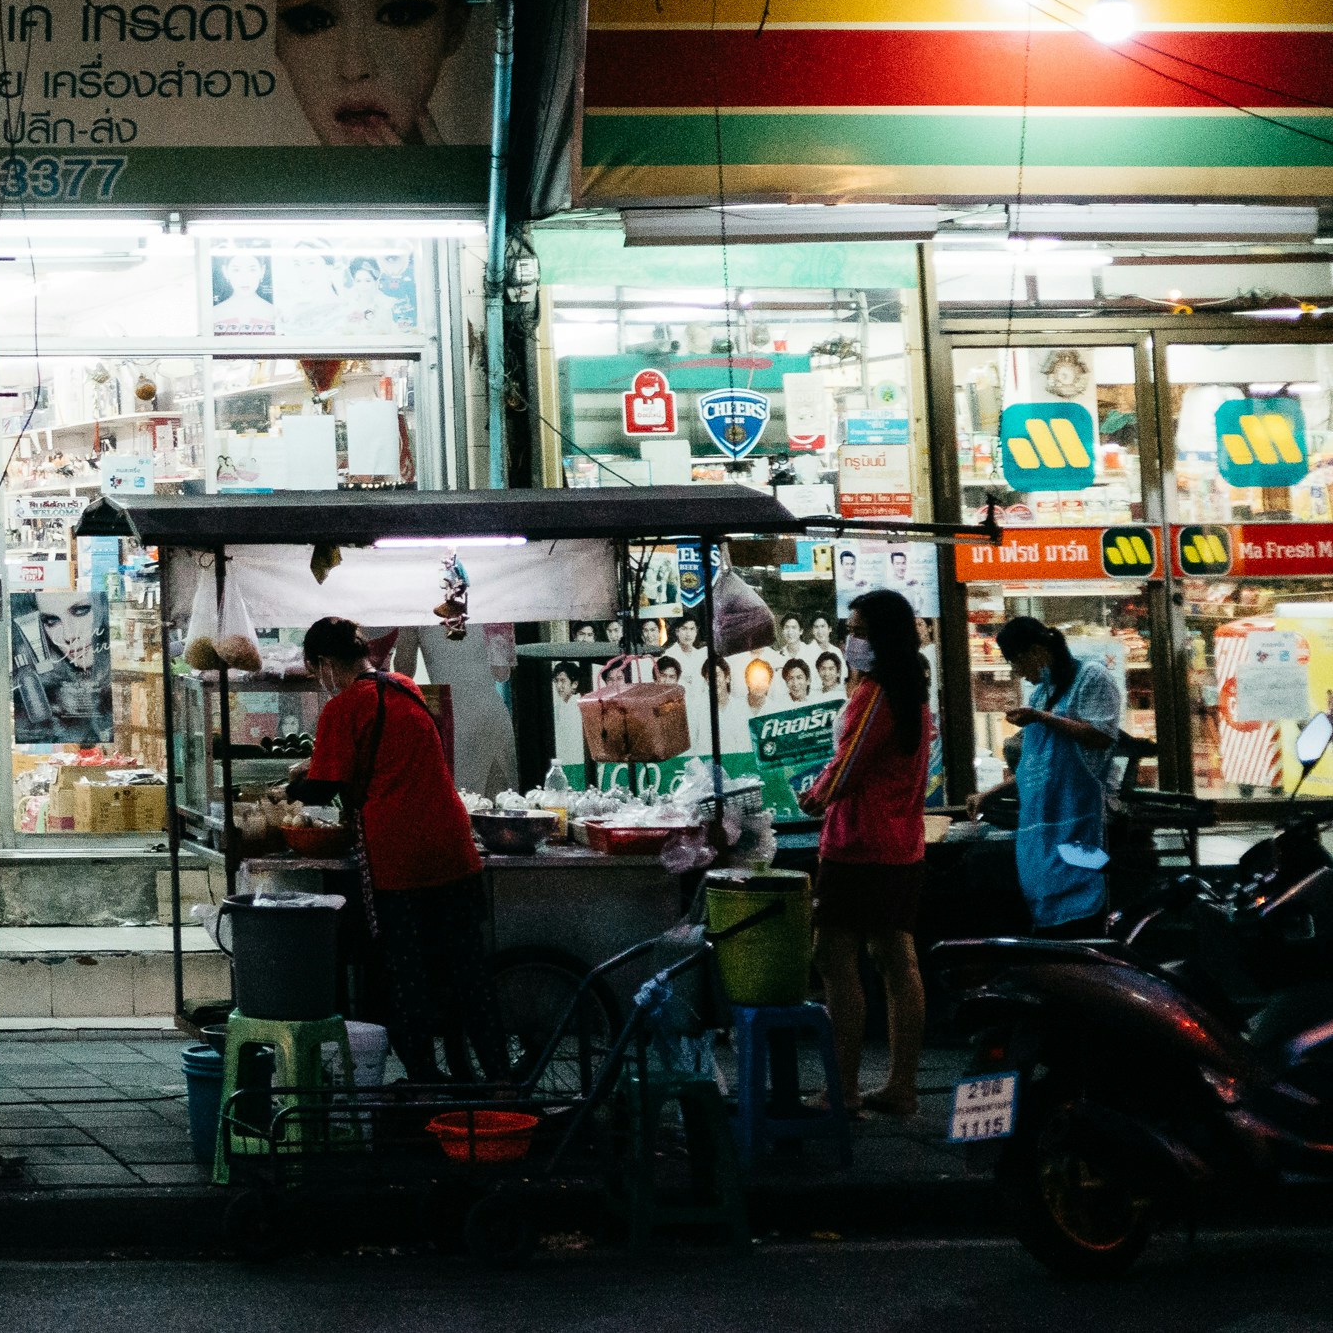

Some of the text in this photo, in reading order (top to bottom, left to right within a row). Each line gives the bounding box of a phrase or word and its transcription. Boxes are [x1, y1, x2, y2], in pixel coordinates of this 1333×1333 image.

[7, 4, 54, 42] เค
[42, 56, 277, 101] เครื่องสำอาง
[703, 401, 767, 420] CHEERS
[972, 544, 994, 564] มา
[1239, 542, 1262, 559] Ma
[1265, 541, 1315, 559] Fresh
